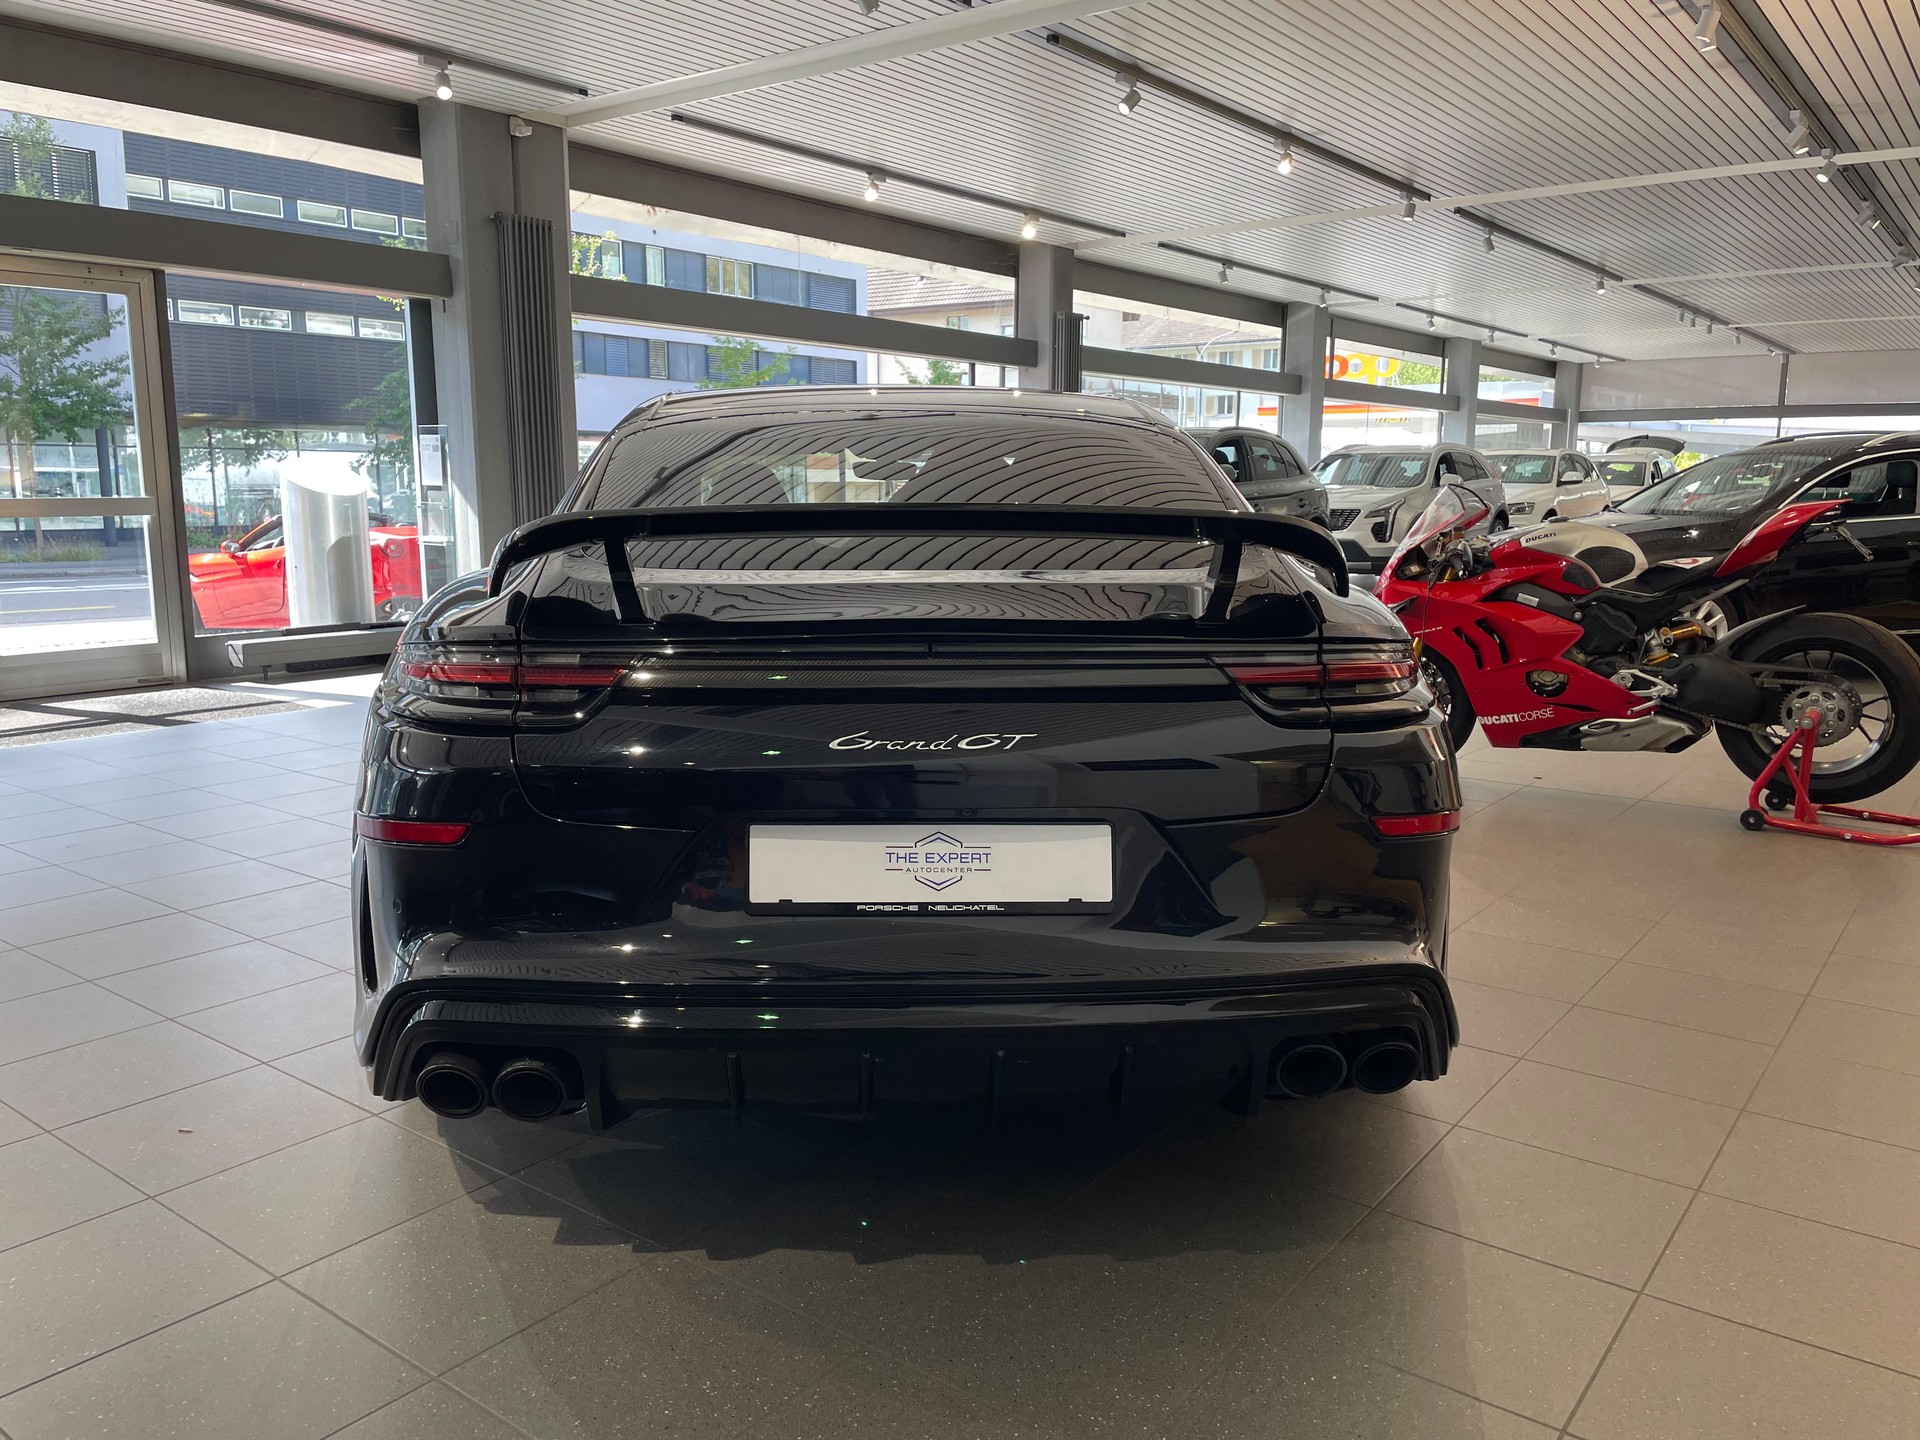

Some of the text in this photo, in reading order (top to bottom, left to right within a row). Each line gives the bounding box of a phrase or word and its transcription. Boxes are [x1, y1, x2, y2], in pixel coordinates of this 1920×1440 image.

[1324, 352, 1401, 386] oop
[1525, 532, 1557, 543] DUCATI
[828, 730, 1039, 750] Grand GT
[885, 852, 992, 864] THE EXPERT
